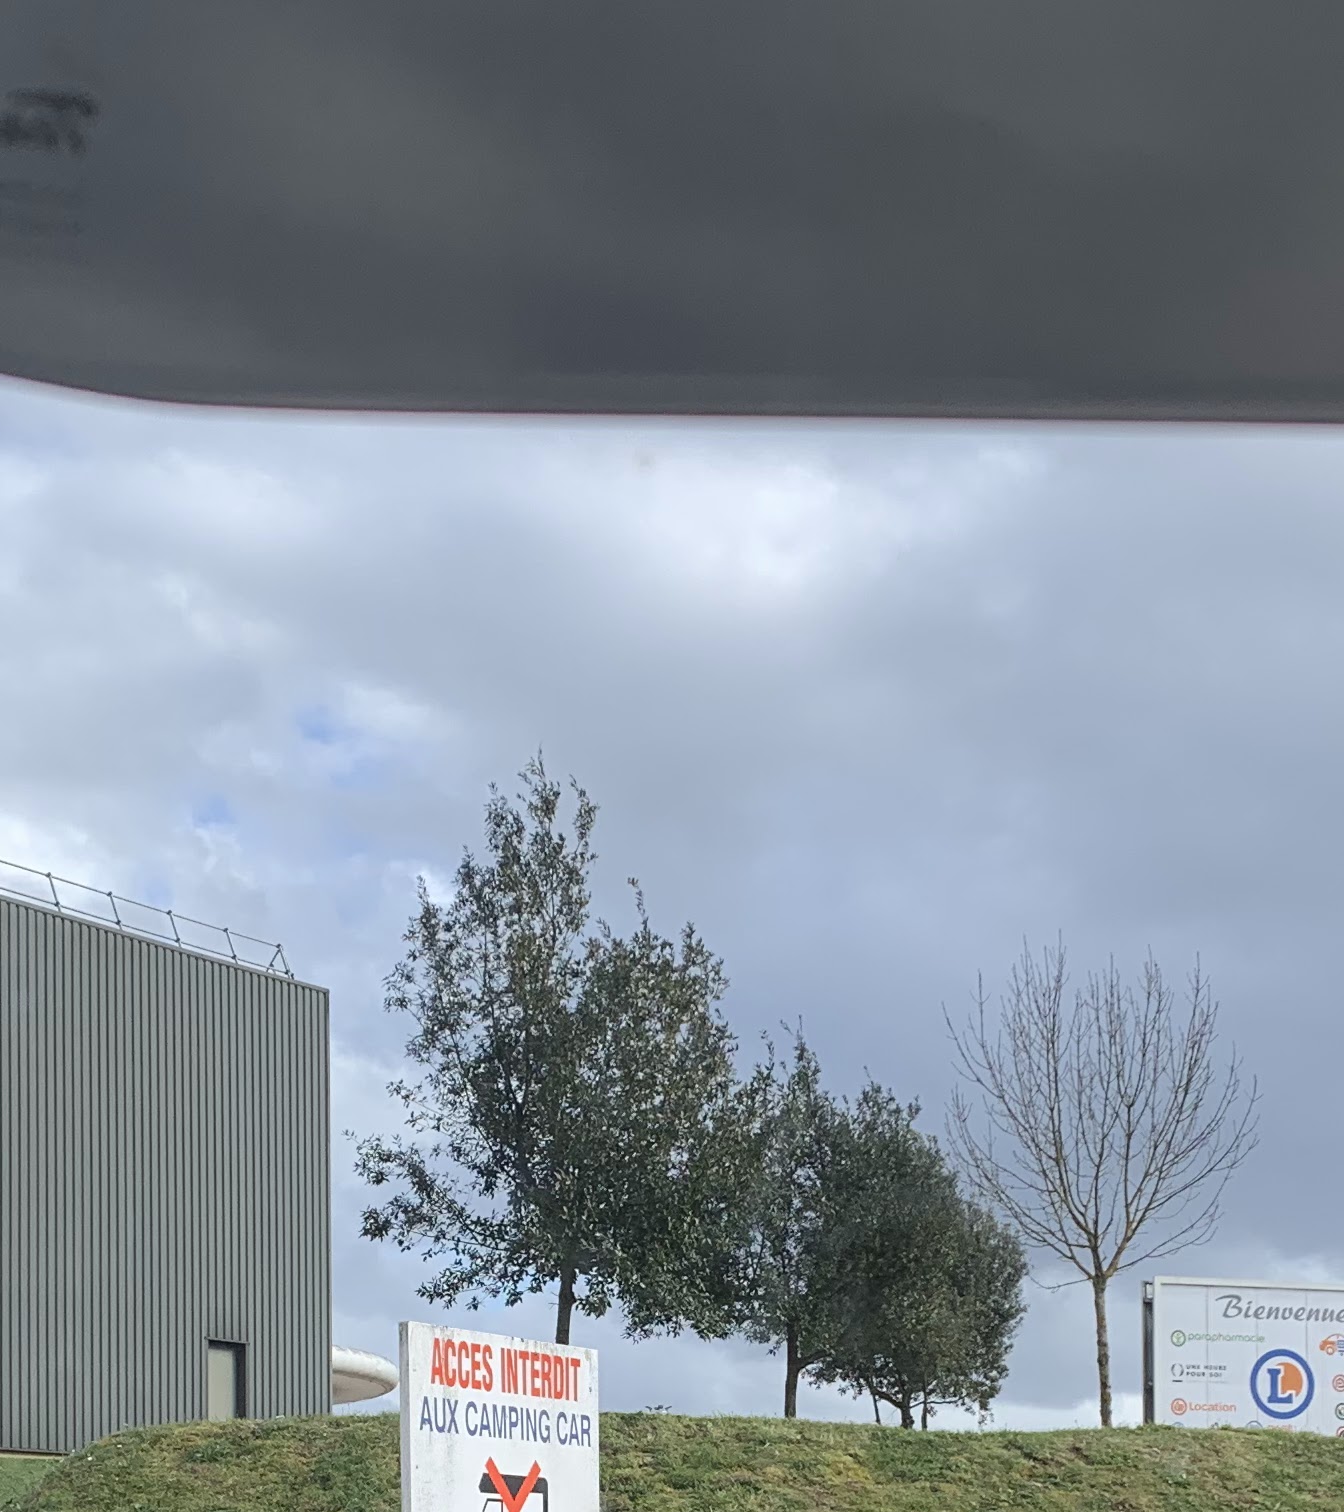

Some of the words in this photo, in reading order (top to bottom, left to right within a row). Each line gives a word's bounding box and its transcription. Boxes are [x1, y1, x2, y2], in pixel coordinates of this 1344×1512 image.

[1187, 1332, 1265, 1344] parapharmacie
[430, 1337, 493, 1393] ACCES
[501, 1347, 581, 1402] INTERDIT
[1267, 1367, 1293, 1404] L
[419, 1395, 460, 1434] AUX
[465, 1401, 551, 1444] CAMPING
[556, 1411, 591, 1448] CAR
[1189, 1401, 1237, 1412] Location
